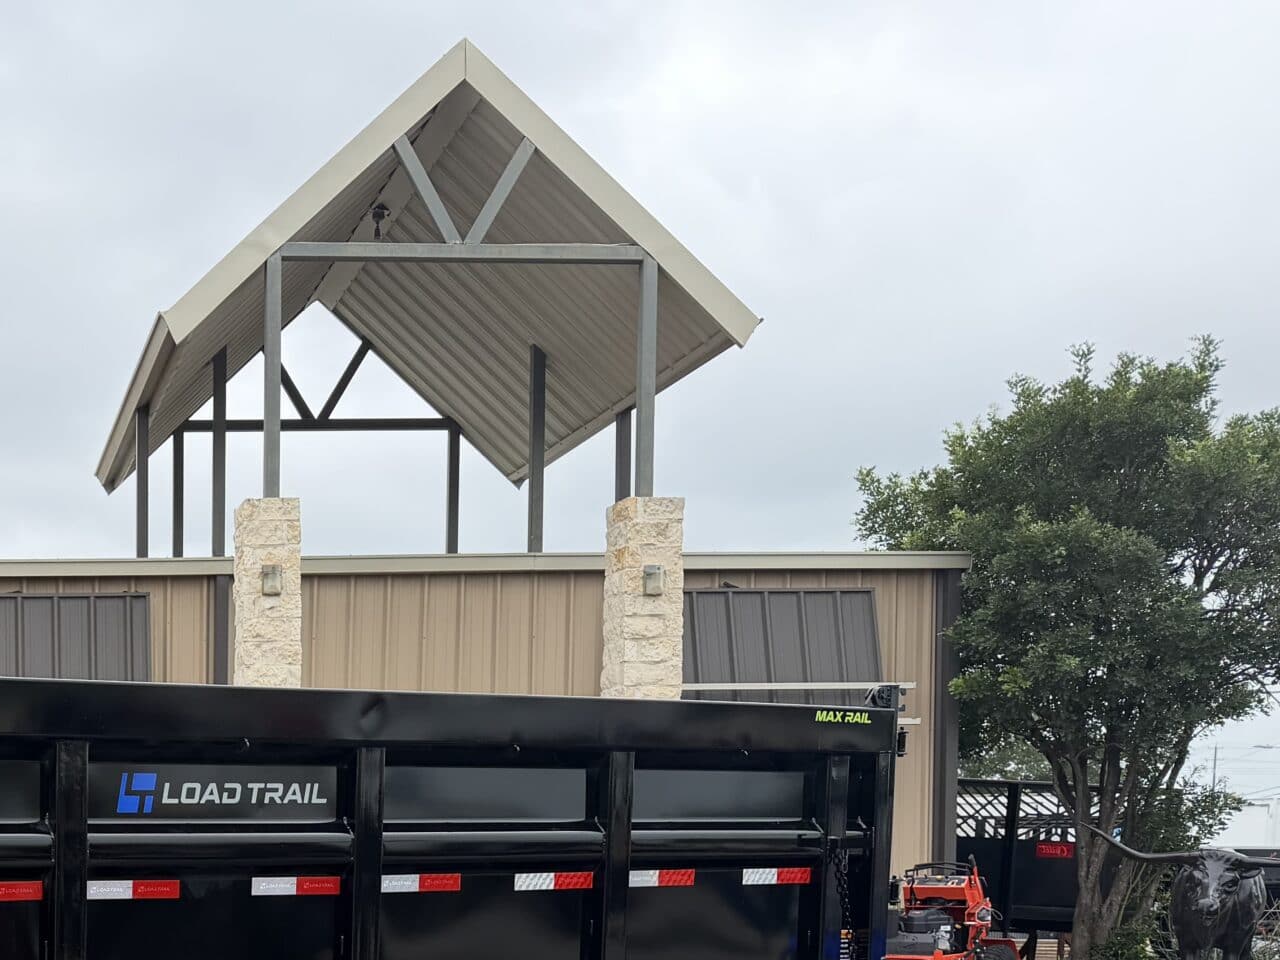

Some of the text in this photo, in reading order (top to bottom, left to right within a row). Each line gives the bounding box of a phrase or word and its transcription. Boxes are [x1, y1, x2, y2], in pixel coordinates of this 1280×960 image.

[815, 710, 872, 724] MAX RAIL
[161, 782, 328, 804] LOAD TRAIL
